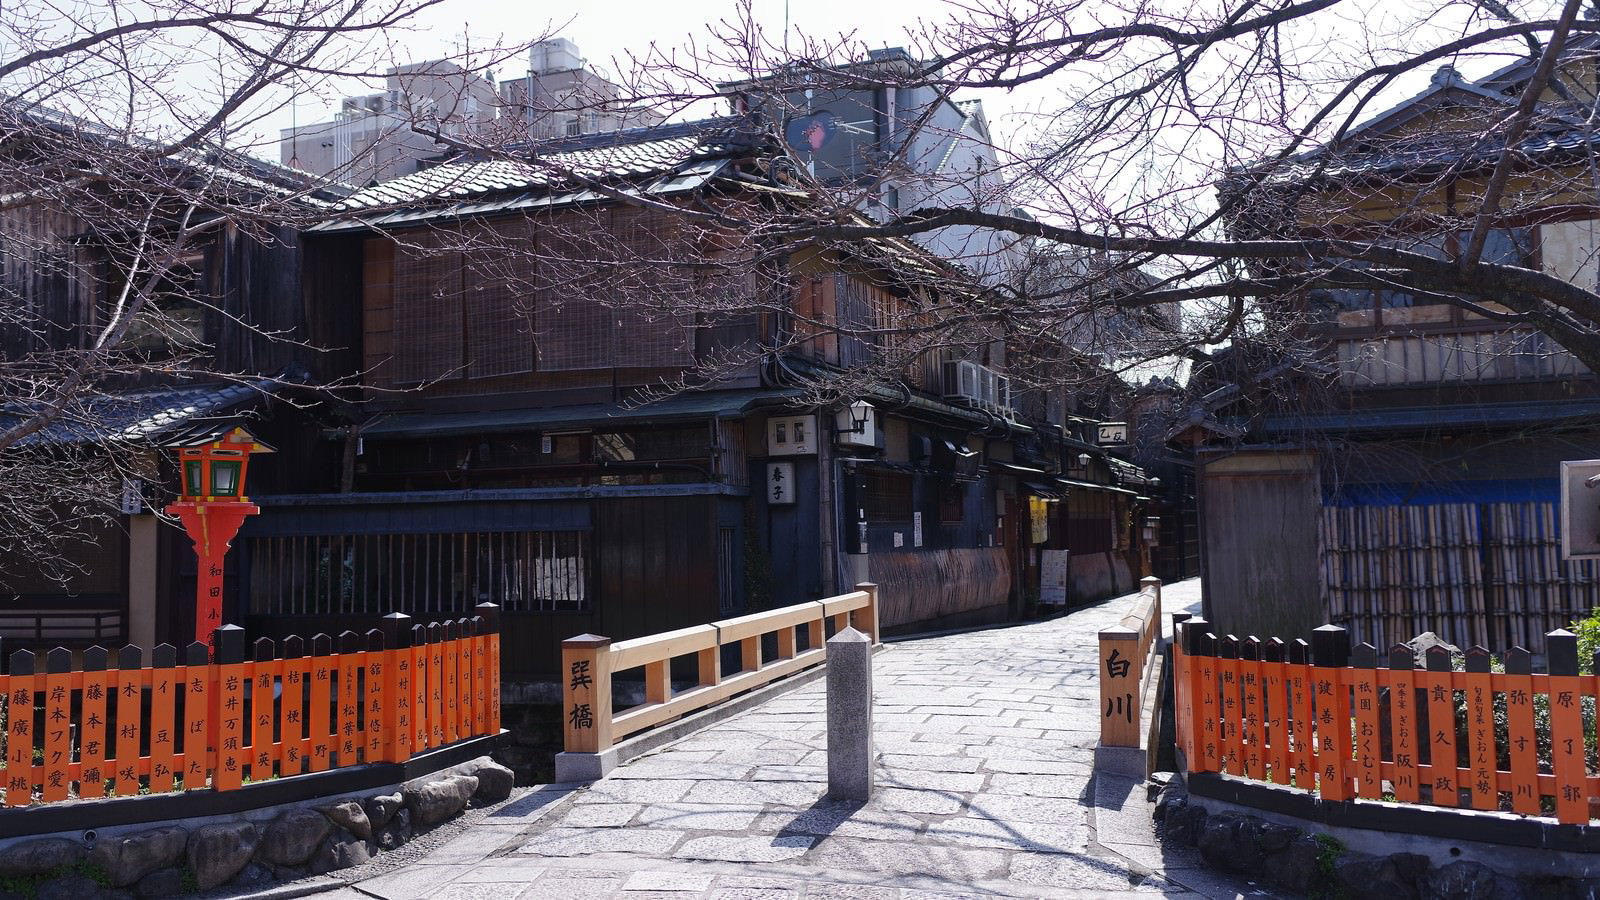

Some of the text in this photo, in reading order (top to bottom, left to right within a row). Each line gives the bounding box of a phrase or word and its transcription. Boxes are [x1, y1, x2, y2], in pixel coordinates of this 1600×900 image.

[772, 466, 784, 500] 春子
[83, 683, 104, 784] 藤本君彌
[120, 682, 138, 781] 木村咲
[189, 678, 205, 774] 志ばた
[224, 675, 239, 772] 岩井万須恵
[258, 673, 270, 767] 蒲公英
[287, 670, 300, 762] 桔梗家
[315, 667, 328, 758] 佐野
[569, 660, 592, 729] 巽橋
[1105, 649, 1132, 723] 白川
[1319, 680, 1336, 781] 鍵善良房
[9, 688, 31, 791] 藤廣小桃
[48, 686, 67, 787] 岸本フク愛
[1432, 684, 1454, 793] 貴久政
[1510, 690, 1532, 799] 弥す川
[1557, 691, 1580, 802] 原了郭
